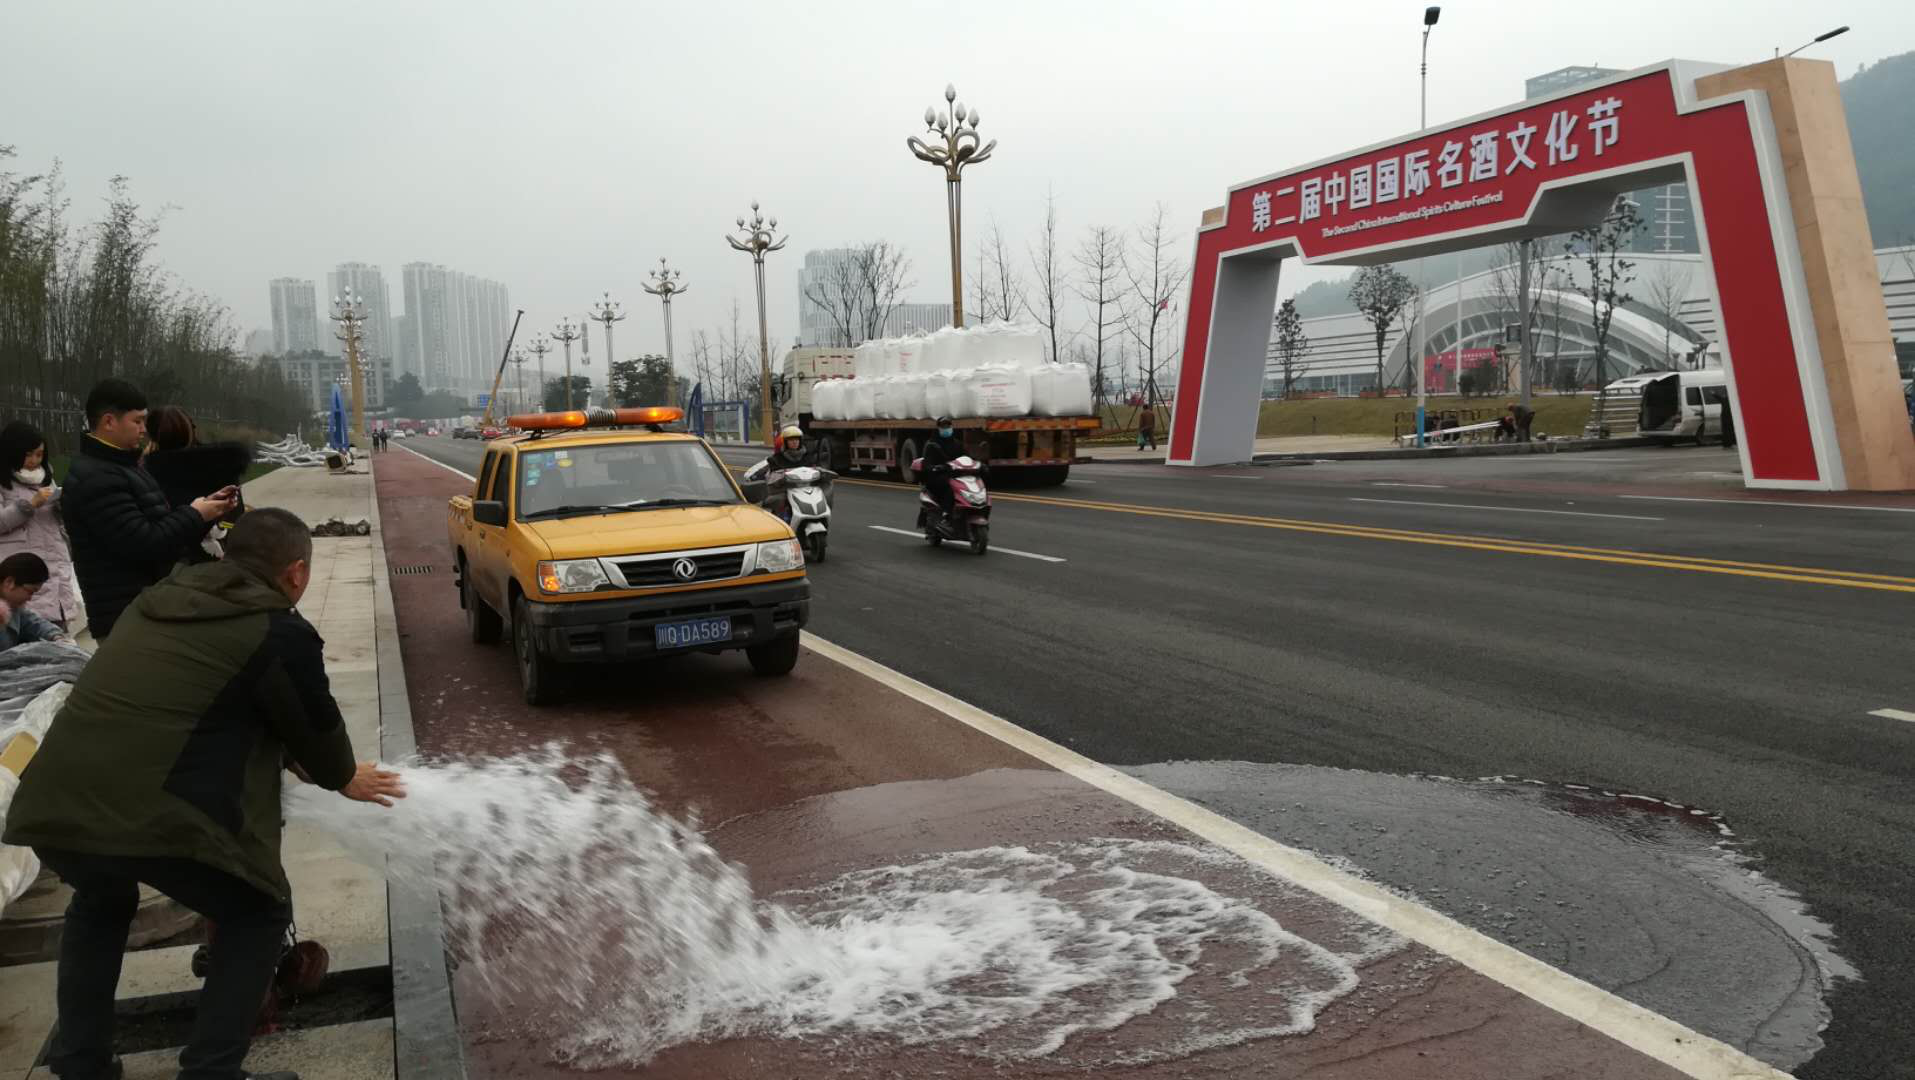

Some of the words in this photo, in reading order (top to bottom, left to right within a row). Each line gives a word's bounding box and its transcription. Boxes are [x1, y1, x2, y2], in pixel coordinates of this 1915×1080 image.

[1252, 97, 1622, 233] 第二届中国国际名酒文化节
[1321, 227, 1334, 238] The
[1334, 221, 1359, 236] Second
[1420, 206, 1443, 220] Spirits
[1443, 200, 1472, 213] Culture
[1472, 190, 1503, 207] Festival
